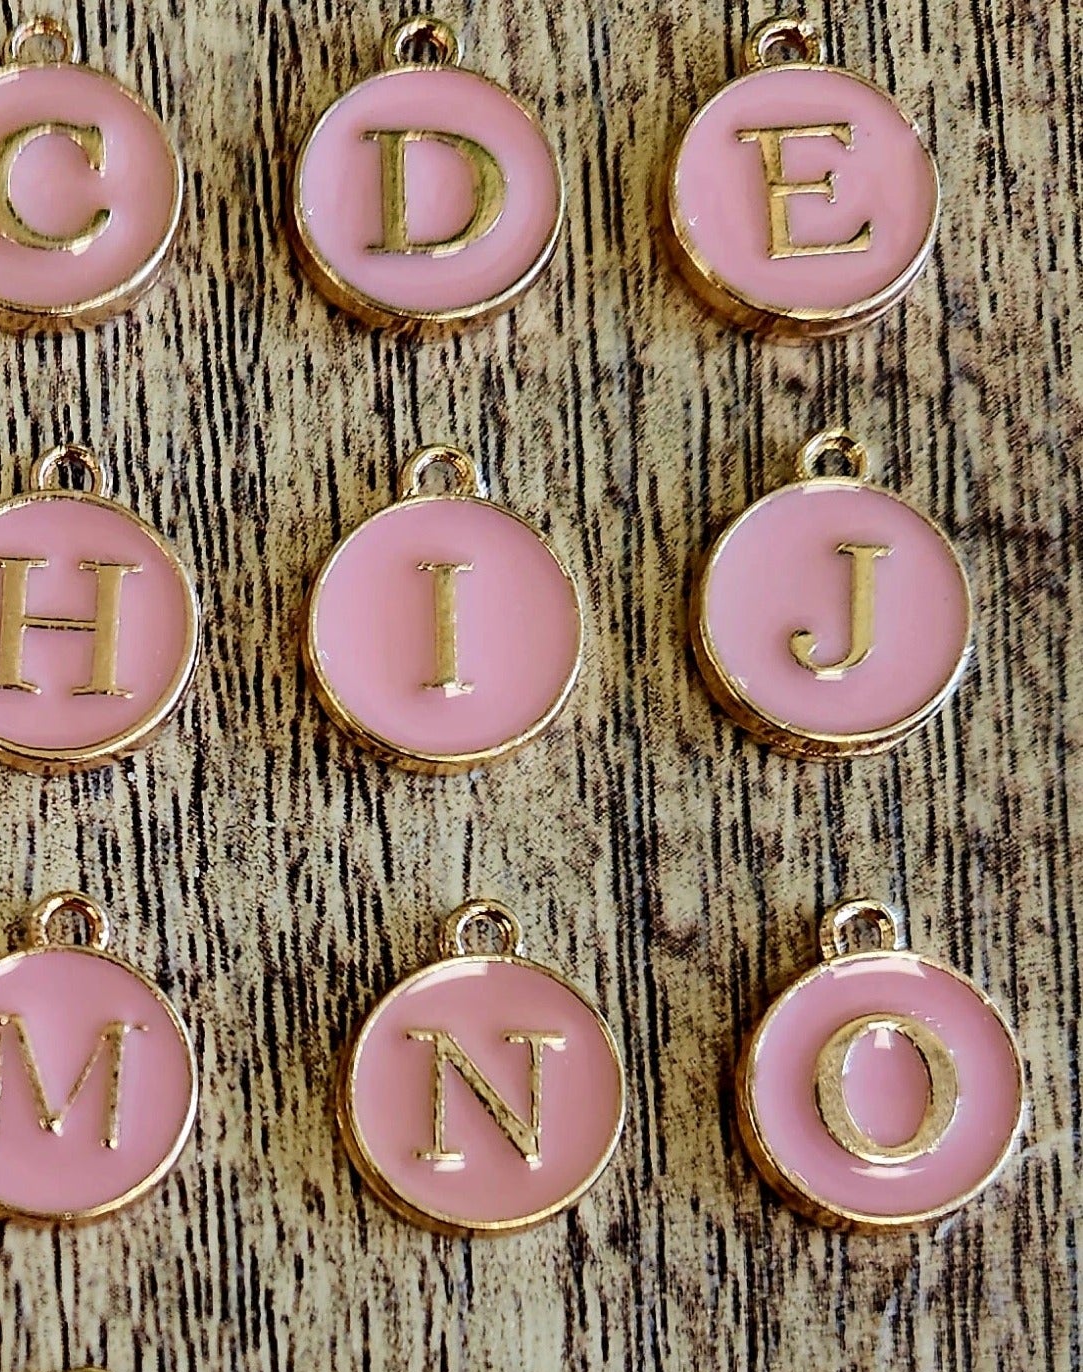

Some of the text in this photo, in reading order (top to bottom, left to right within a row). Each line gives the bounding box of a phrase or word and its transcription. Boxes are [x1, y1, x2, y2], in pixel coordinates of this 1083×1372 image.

[359, 129, 509, 255] D
[736, 122, 874, 260] E
[417, 561, 474, 695] I
[789, 542, 895, 679] J
[405, 1029, 566, 1169] N
[813, 1012, 959, 1164] O
